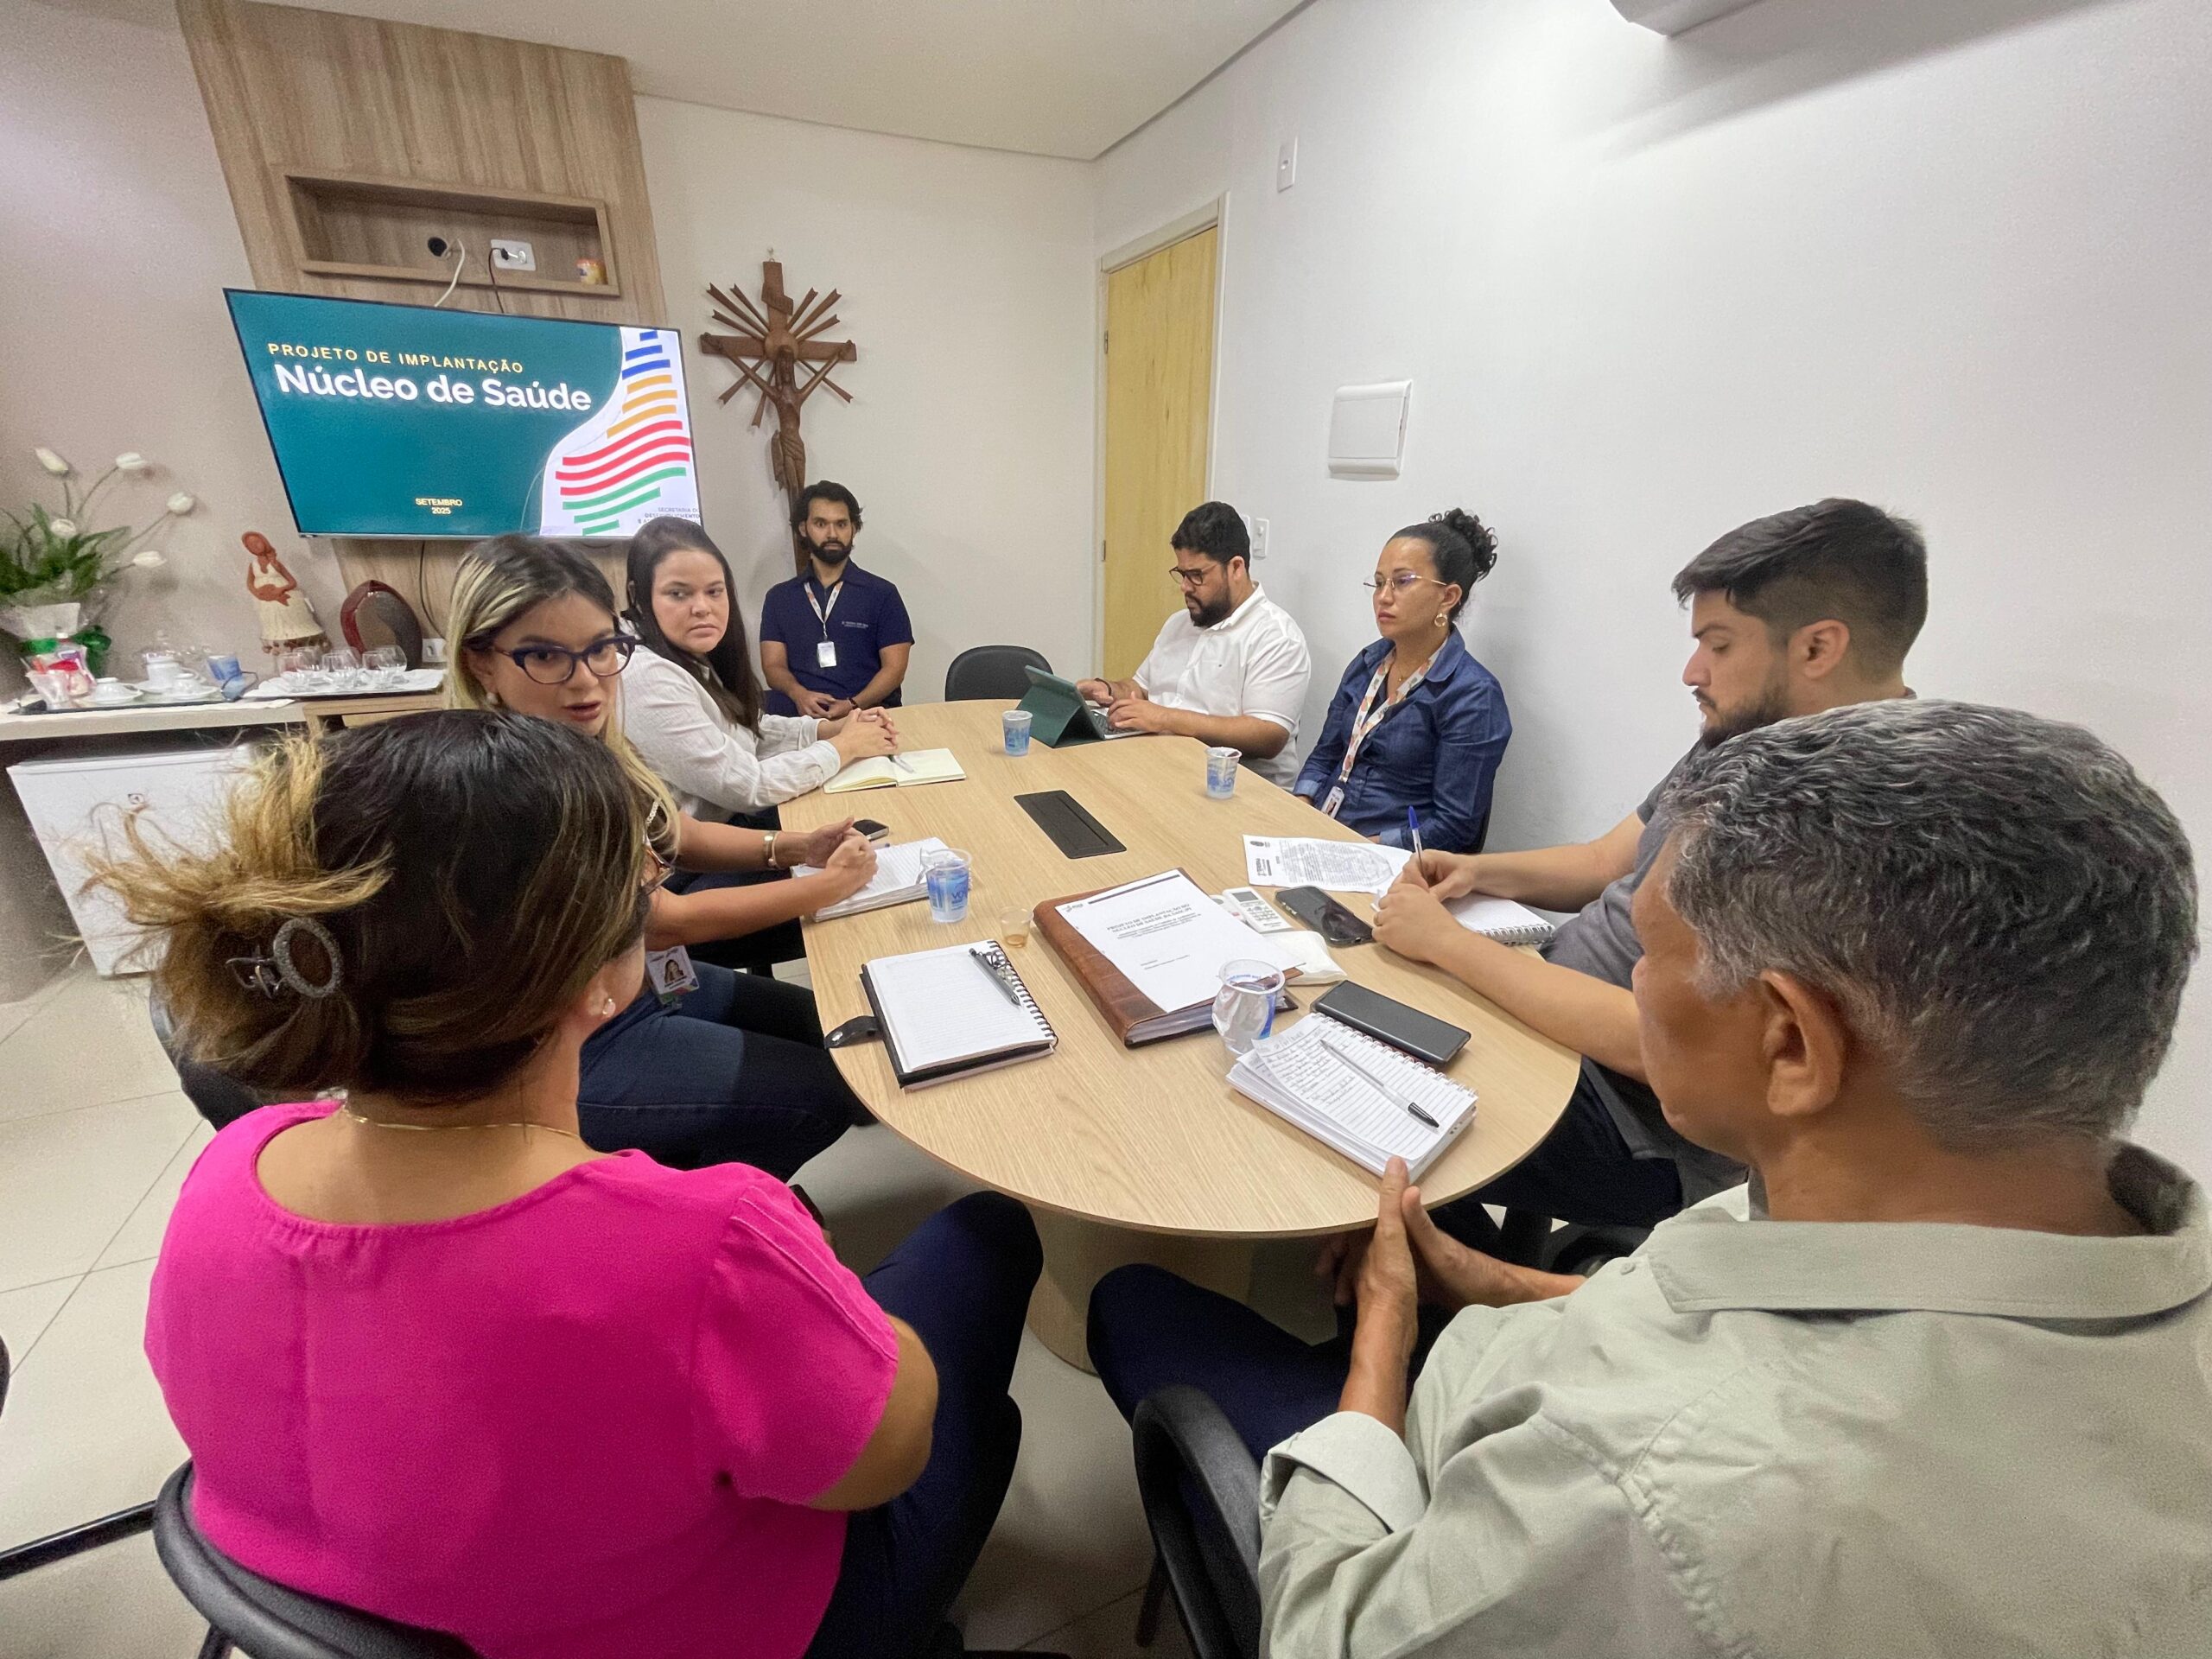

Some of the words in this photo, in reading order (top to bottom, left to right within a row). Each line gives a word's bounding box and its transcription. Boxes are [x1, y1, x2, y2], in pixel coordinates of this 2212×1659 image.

[267, 342, 358, 361] PROJETO
[365, 350, 391, 364] DE
[397, 353, 524, 374] IMPLANTAÇÃO
[274, 363, 418, 401] Núcleo
[426, 374, 475, 404] de
[481, 378, 592, 411] Saúde
[415, 497, 463, 506] SETEMBRO
[431, 506, 452, 515] 2025
